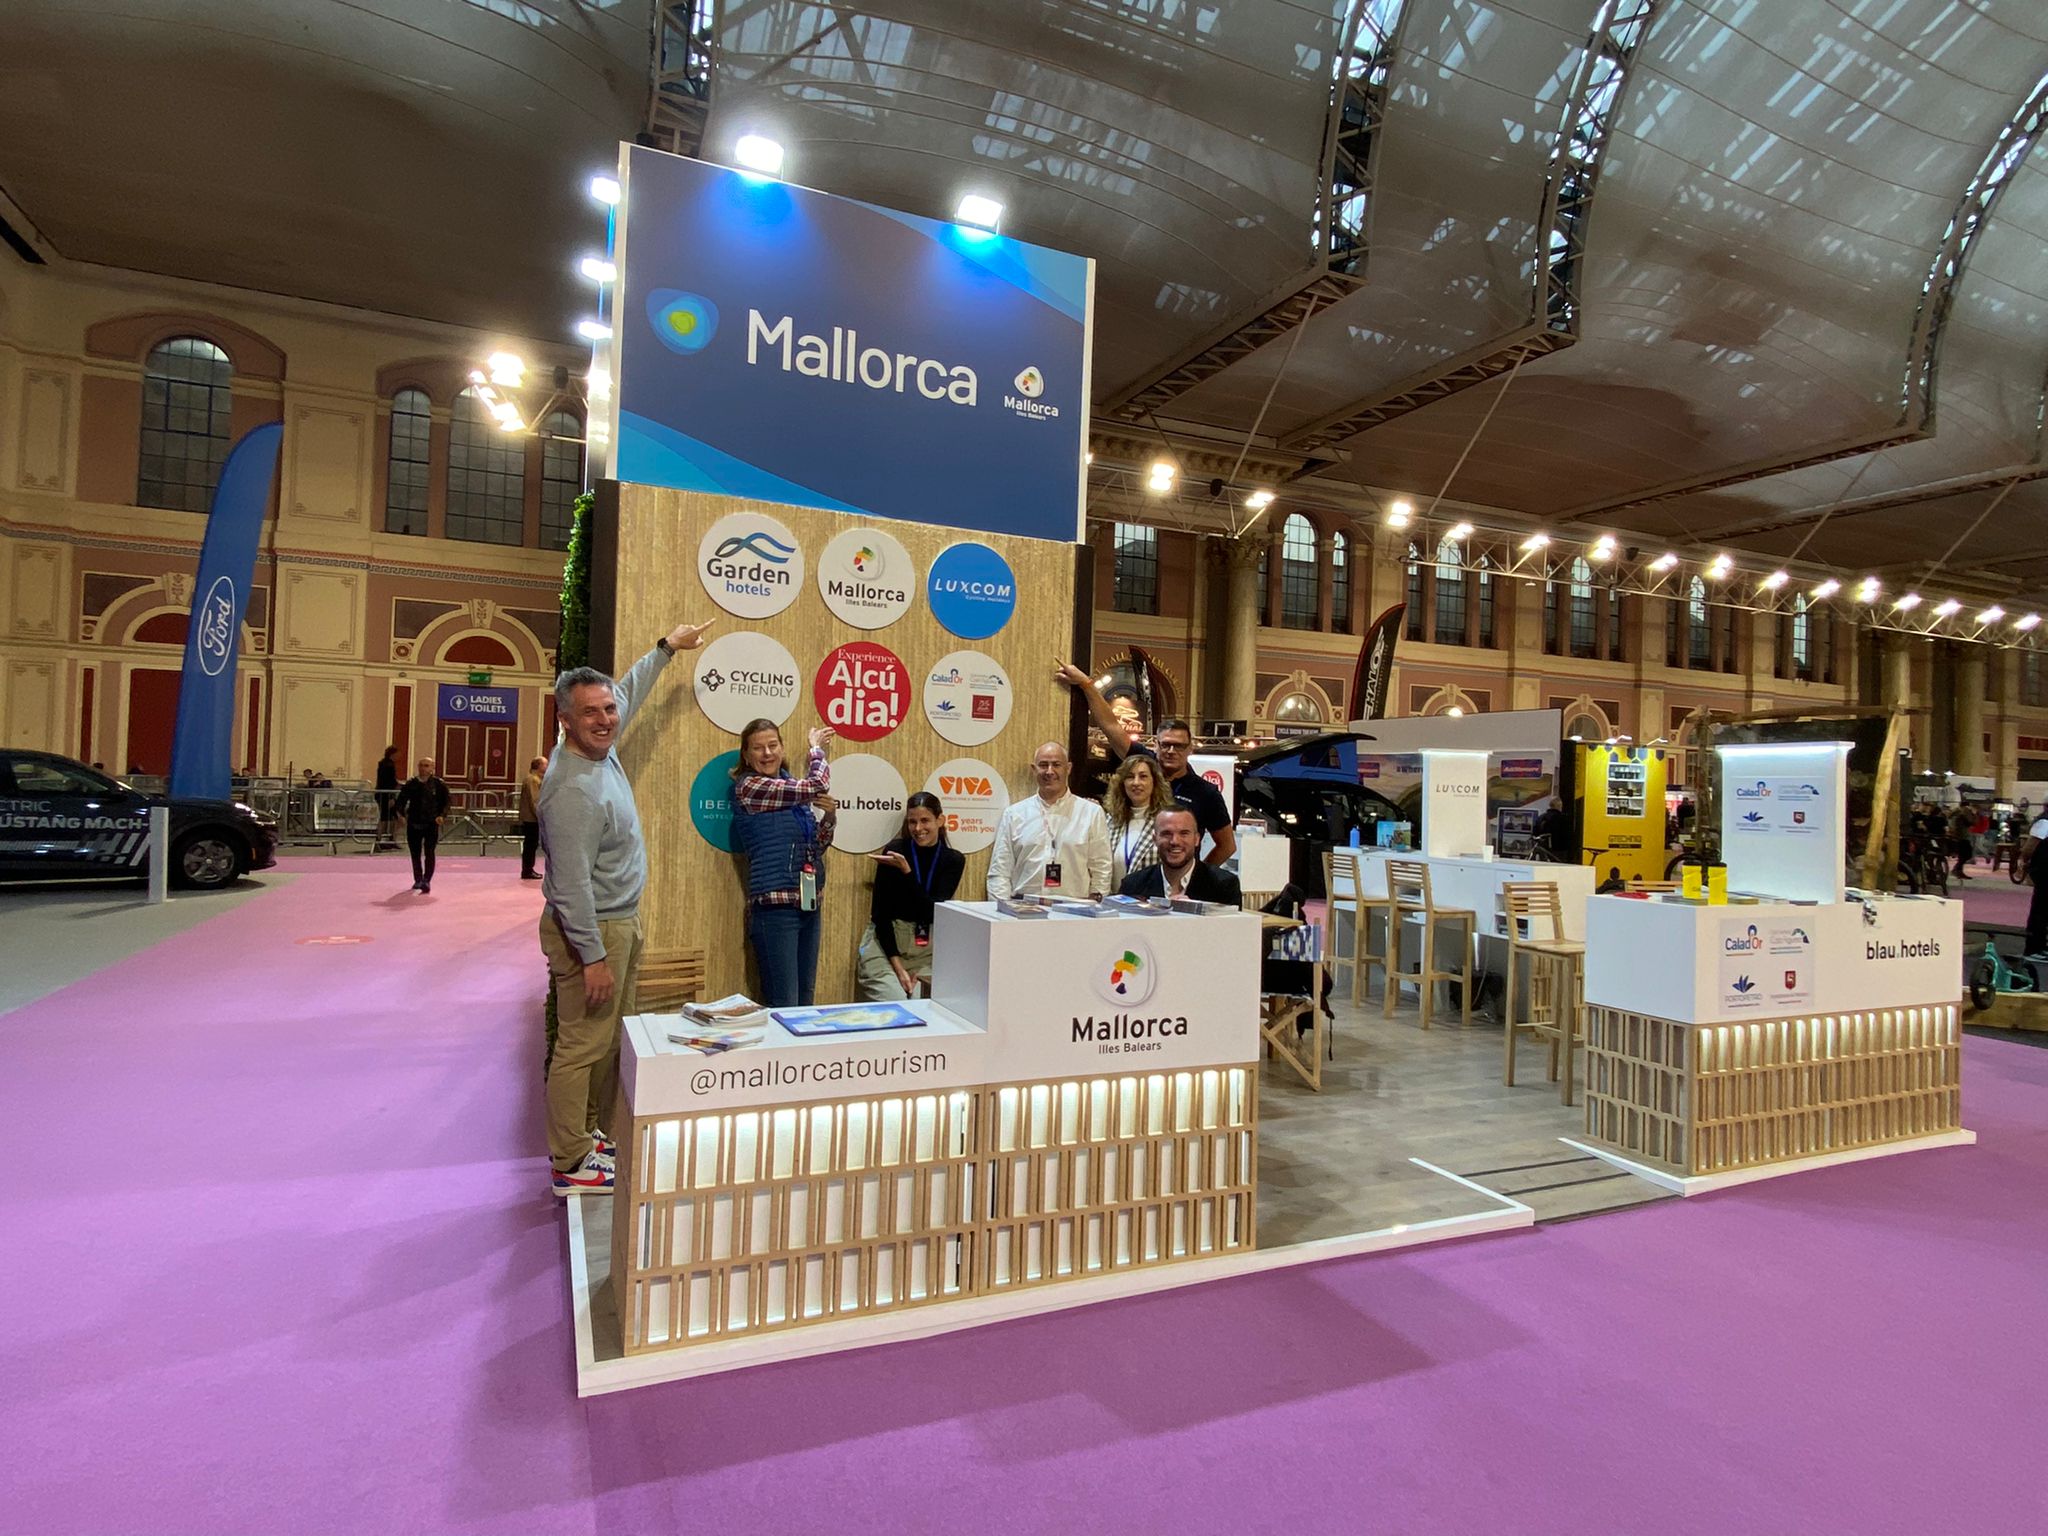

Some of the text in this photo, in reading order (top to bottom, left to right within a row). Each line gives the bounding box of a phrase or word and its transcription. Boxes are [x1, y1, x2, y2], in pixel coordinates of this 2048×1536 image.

[747, 308, 978, 407] Mallorca
[1004, 395, 1059, 417] Mallorca
[706, 558, 790, 585] Garden
[726, 580, 772, 597] hotels
[828, 580, 905, 602] Mallorca
[934, 578, 1011, 597] LUXCOM
[845, 599, 888, 609] Illes Balears
[203, 596, 231, 656] Ford
[838, 649, 897, 663] Experience
[730, 670, 794, 686] CYCLING
[828, 660, 896, 690] Alcú
[730, 683, 794, 698] FRIENDLY
[470, 696, 502, 704] LADIES
[470, 704, 506, 713] TOILETS
[827, 688, 899, 728] dia!
[939, 776, 993, 795] VIVA
[1436, 784, 1480, 793] LUXCOM
[84, 817, 149, 829] MACH-
[961, 818, 983, 826] years
[961, 825, 978, 833] with
[1866, 938, 1940, 960] blau.hotels
[1071, 1014, 1188, 1042] Mallorca
[1098, 1042, 1162, 1055] Illes Balears
[690, 1049, 947, 1096] @mallorcatourism
